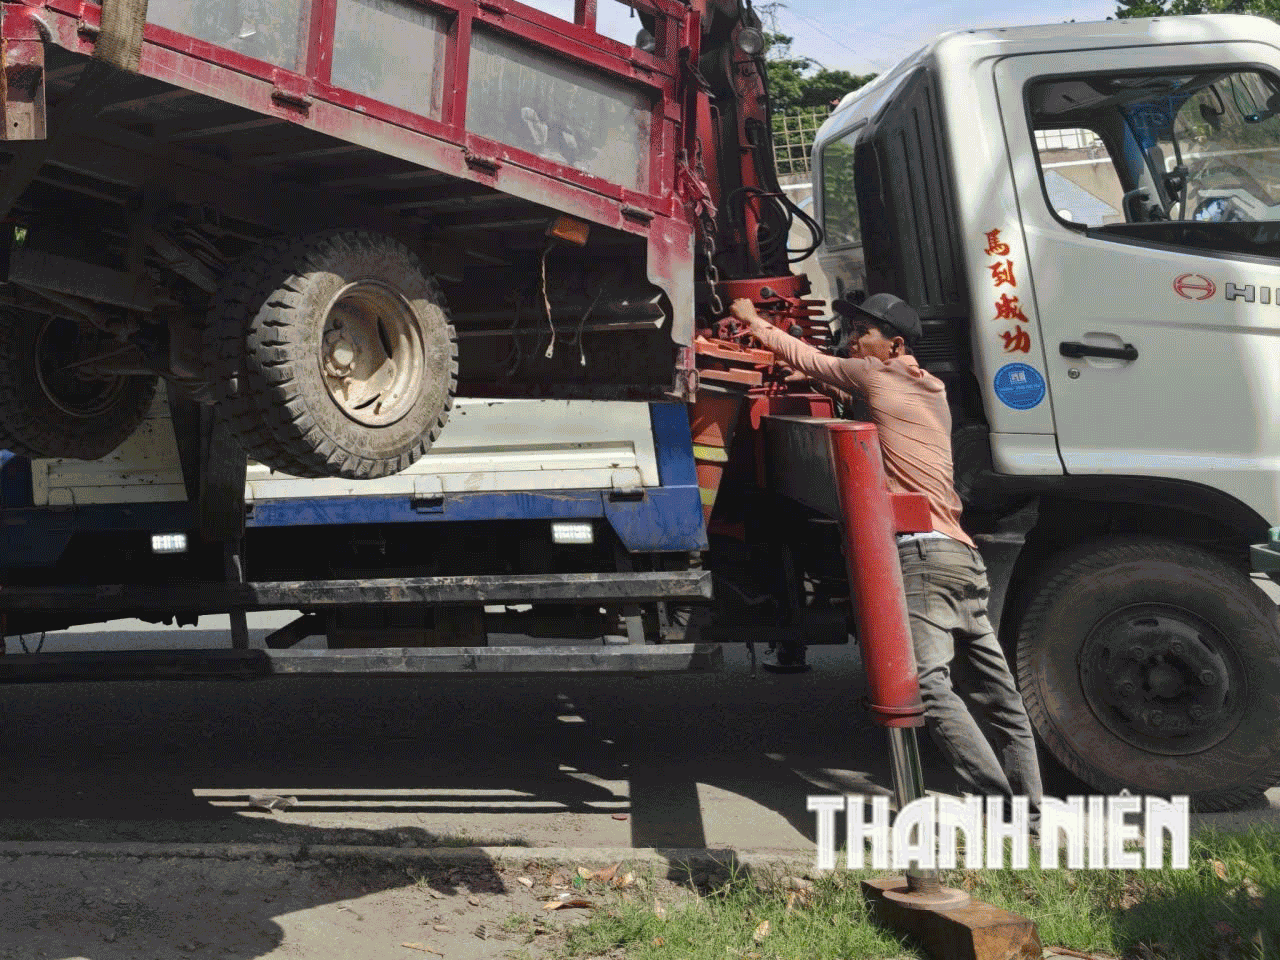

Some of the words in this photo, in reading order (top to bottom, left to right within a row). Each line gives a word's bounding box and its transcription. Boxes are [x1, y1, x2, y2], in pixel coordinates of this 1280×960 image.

[984, 228, 1031, 354] 馬到成功
[1225, 282, 1280, 307] HI
